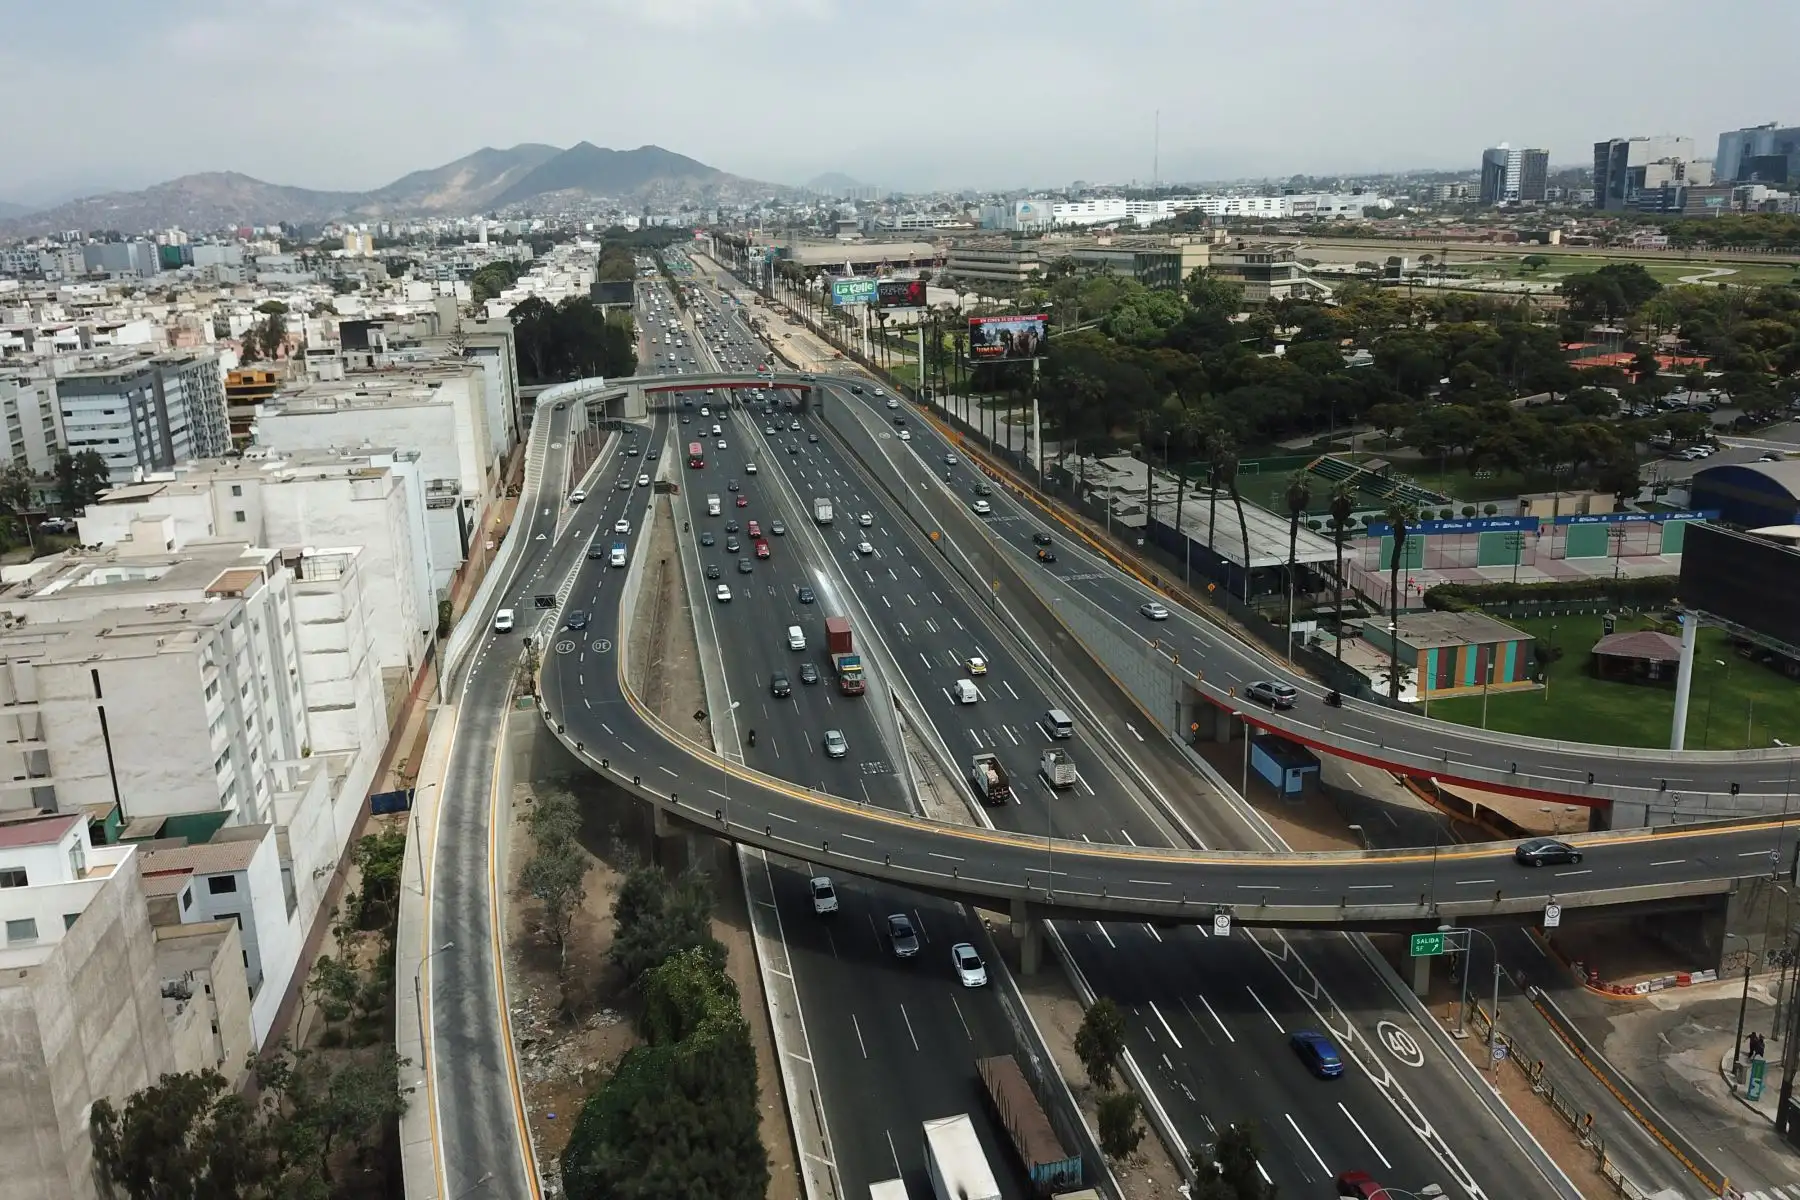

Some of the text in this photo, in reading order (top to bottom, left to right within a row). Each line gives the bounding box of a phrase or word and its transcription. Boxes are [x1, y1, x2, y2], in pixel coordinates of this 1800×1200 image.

[837, 284, 849, 294] La
[849, 282, 873, 294] Kalle
[1416, 937, 1440, 945] SALIDA
[1387, 1031, 1417, 1056] 40
